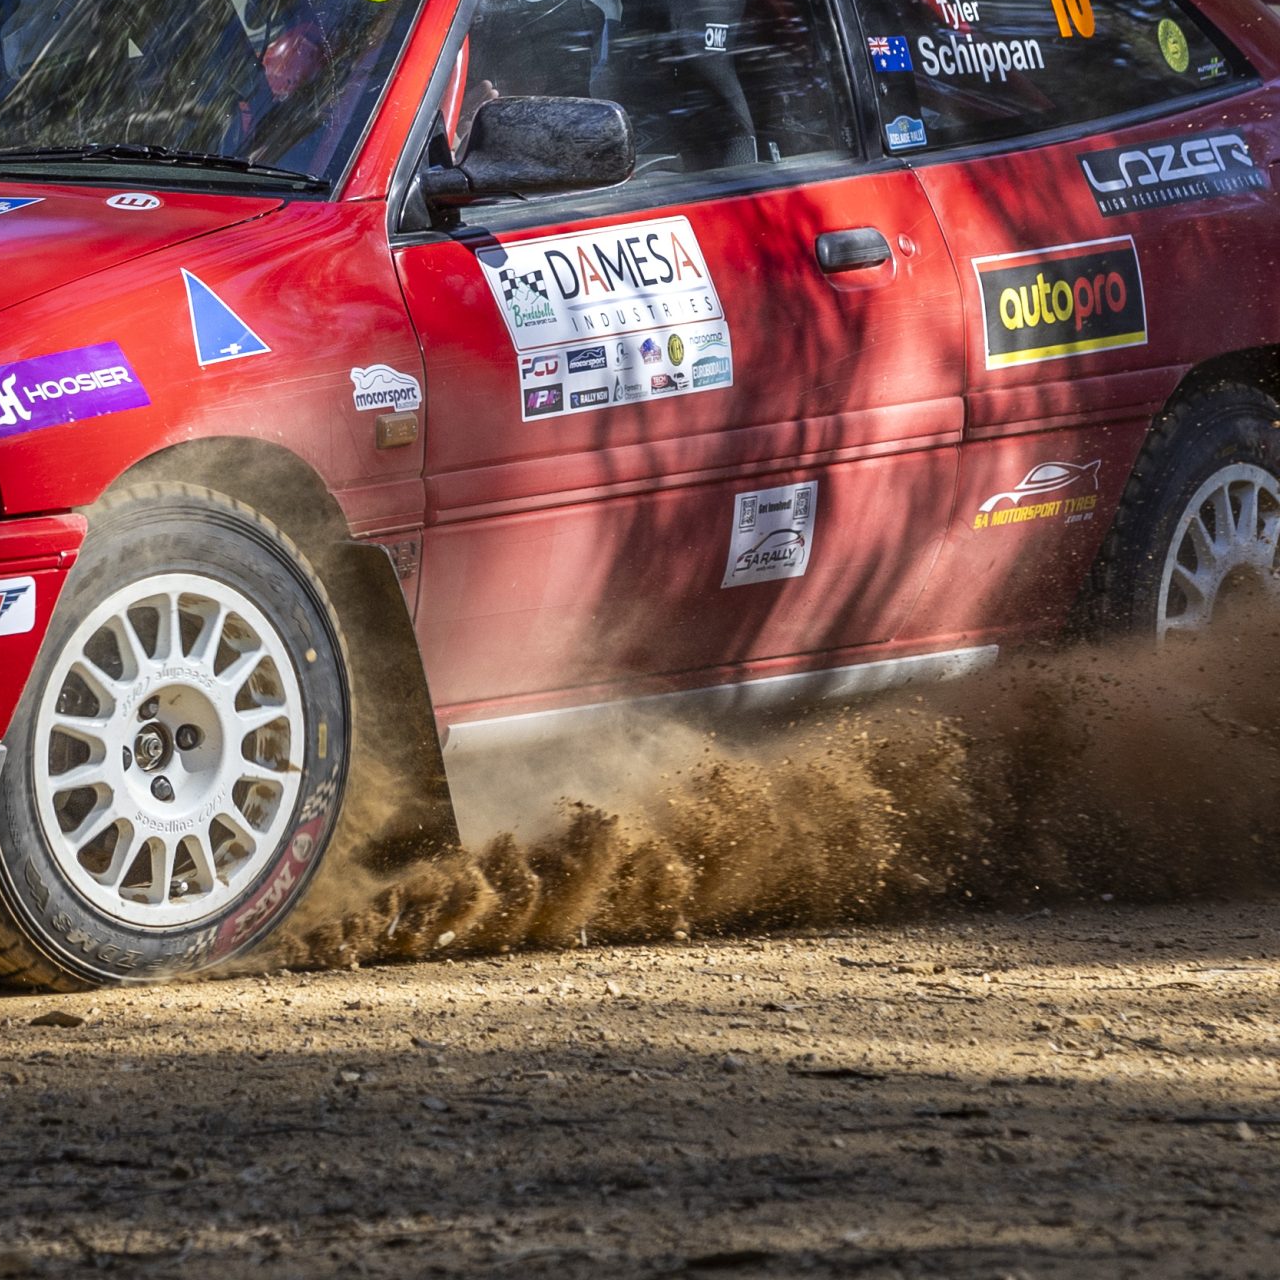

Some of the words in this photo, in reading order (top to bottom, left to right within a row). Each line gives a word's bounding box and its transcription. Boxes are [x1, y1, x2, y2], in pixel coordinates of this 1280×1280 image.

[705, 28, 727, 48] OMP
[919, 34, 1045, 83] Schippan
[1082, 134, 1253, 193] LAZER
[1099, 196, 1128, 213] HIGH
[1132, 181, 1210, 206] PERFORMANCE
[1215, 173, 1263, 192] LIGHTING
[544, 232, 702, 300] DAMESA
[999, 272, 1127, 332] autopro
[689, 332, 723, 345] narooma
[23, 366, 133, 403] HOOSIER
[356, 387, 417, 409] motorsport
[973, 513, 989, 530] SA
[990, 501, 1063, 526] MOTORSPORT
[1064, 495, 1098, 514] TYRES
[759, 548, 797, 564] RALLY
